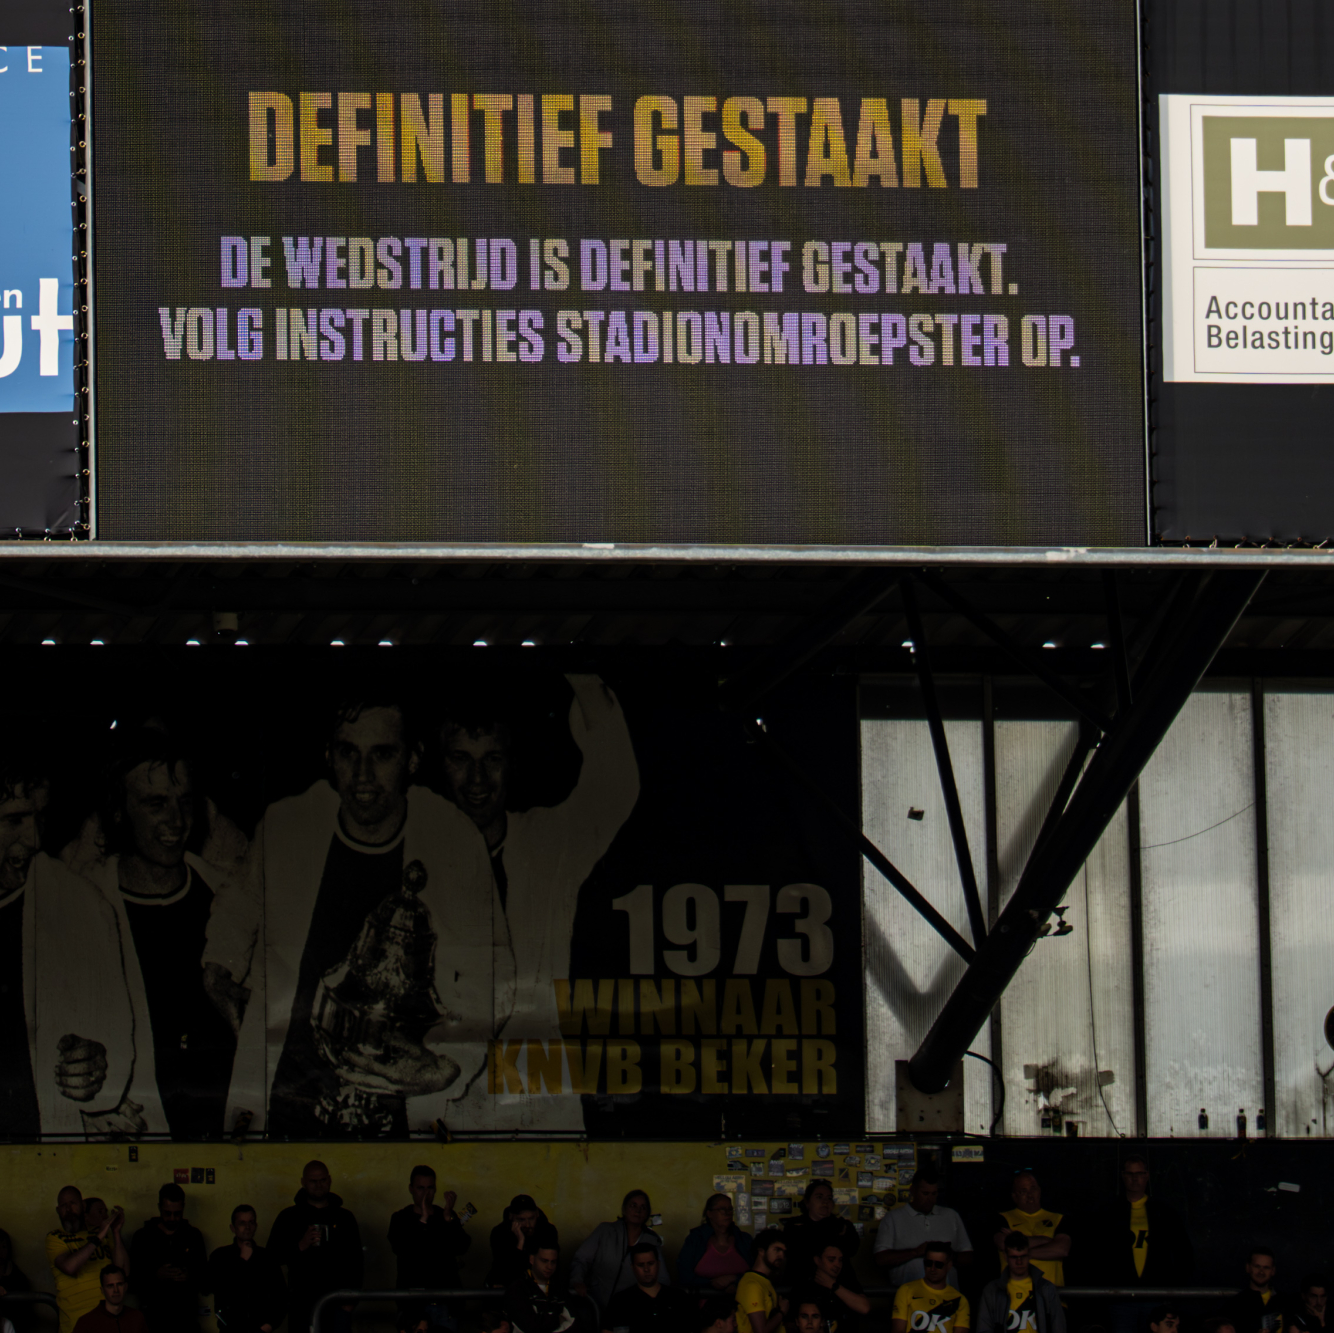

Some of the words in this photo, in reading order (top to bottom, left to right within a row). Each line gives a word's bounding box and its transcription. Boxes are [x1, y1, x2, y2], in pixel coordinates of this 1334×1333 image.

[248, 91, 613, 184] DEFINITIEF
[633, 95, 987, 189] GESTAAKT
[220, 236, 271, 290] DE
[282, 236, 517, 292] WEDSTRIJD
[529, 238, 570, 292] IS
[579, 239, 791, 294] DEFINITIEF
[801, 241, 1018, 296] GESTAAKT.
[159, 306, 264, 362] VOLG
[275, 307, 545, 364] INSTRUCTIES
[556, 309, 1010, 367] STADIONOMROEPSTER
[1020, 314, 1081, 368] OP.
[612, 883, 834, 977] 1973
[554, 978, 837, 1035] WINNAAR
[488, 1039, 642, 1094] KNVB
[660, 1038, 837, 1094] BEKER
[910, 1310, 951, 1333] OK
